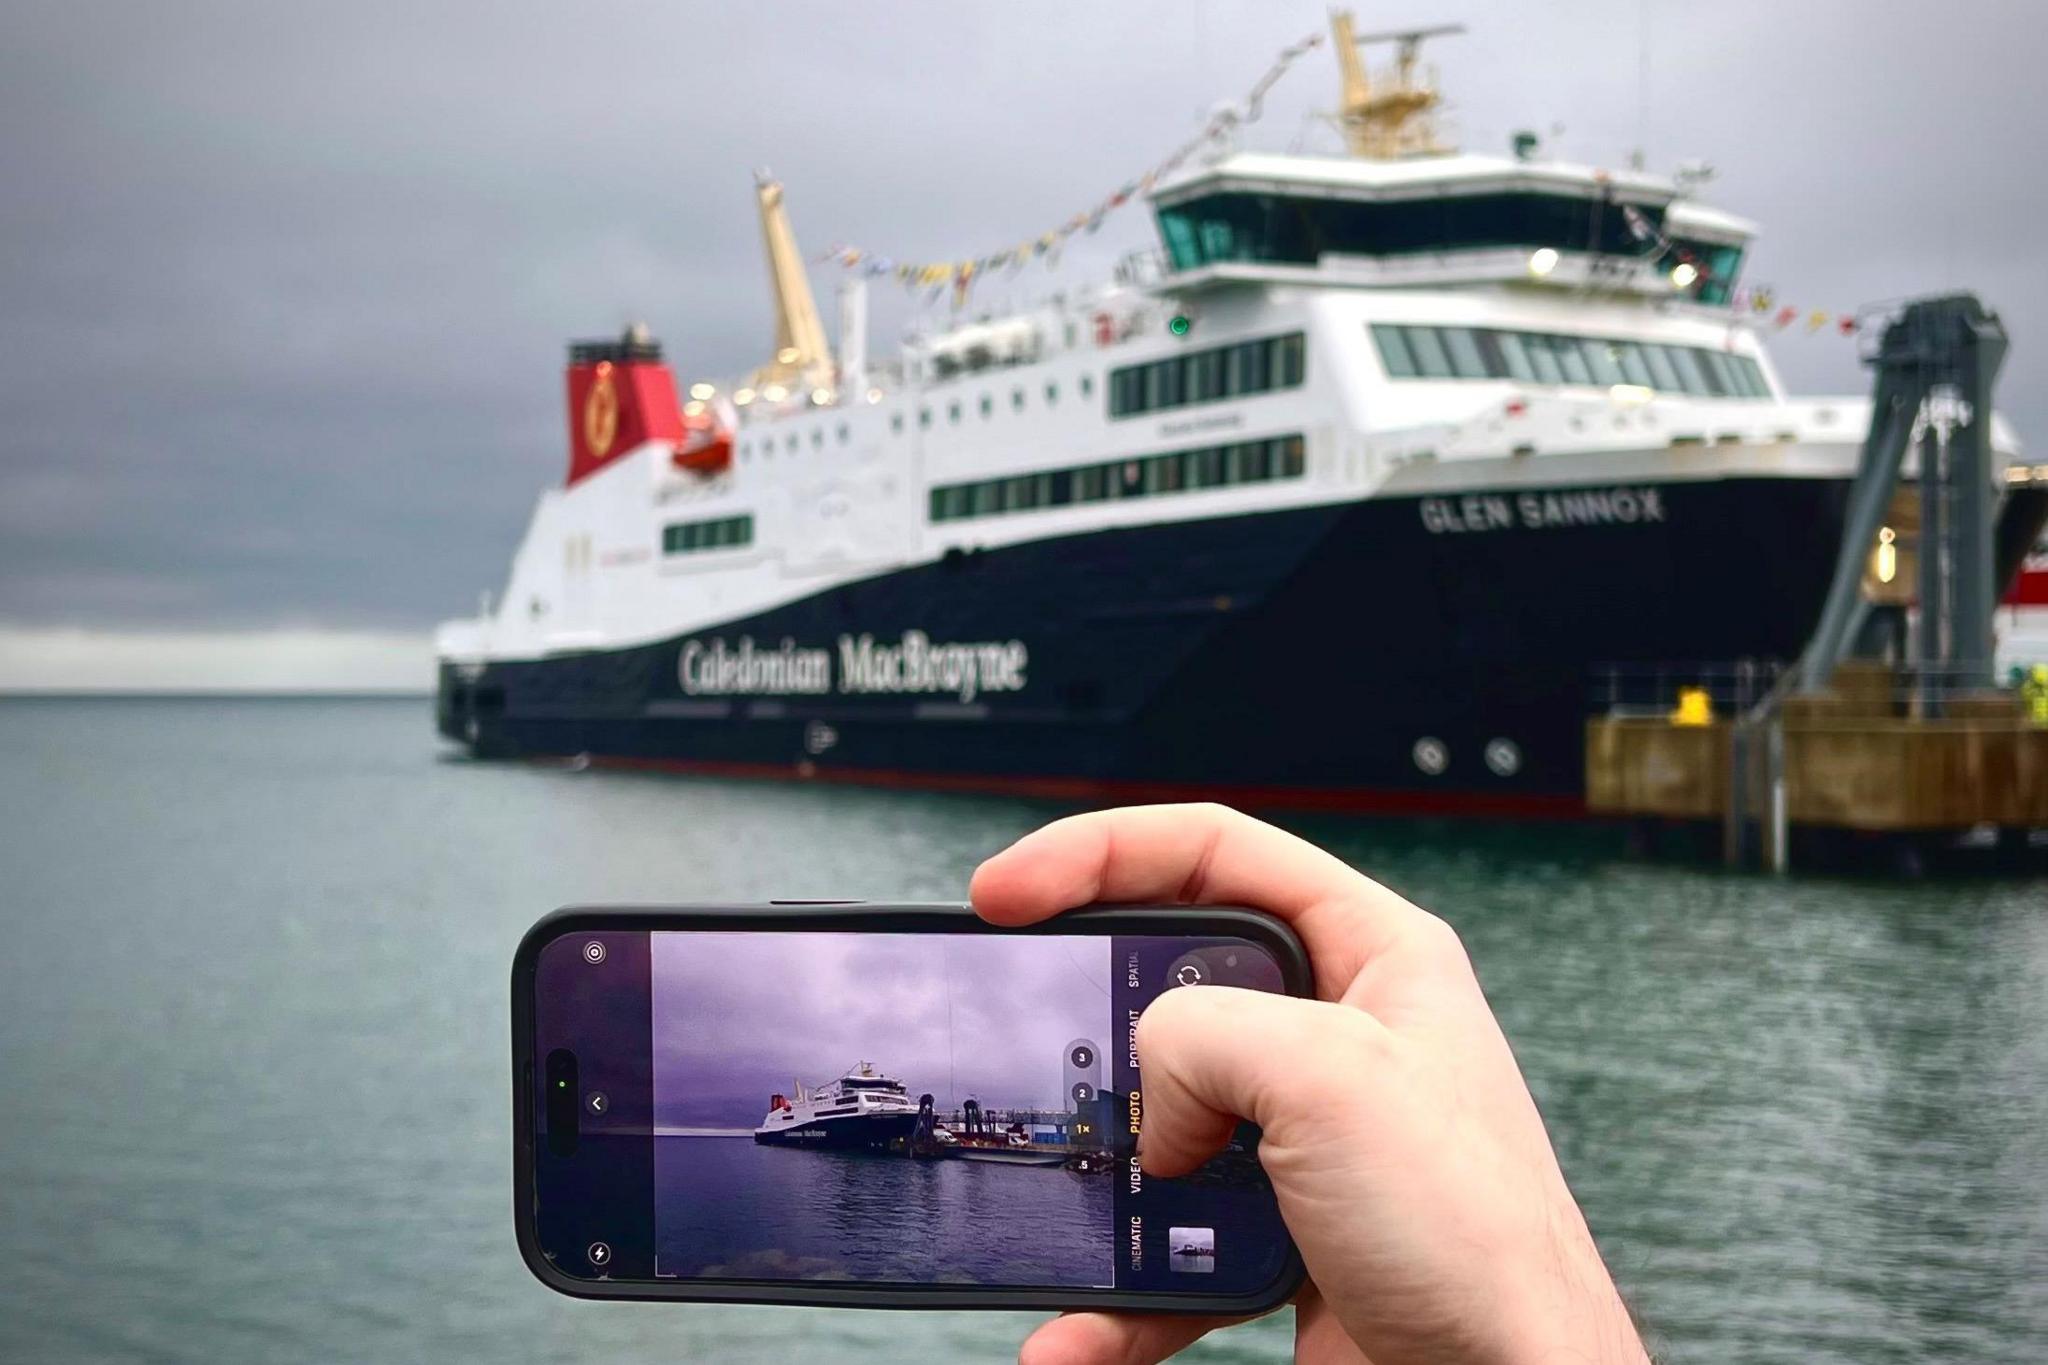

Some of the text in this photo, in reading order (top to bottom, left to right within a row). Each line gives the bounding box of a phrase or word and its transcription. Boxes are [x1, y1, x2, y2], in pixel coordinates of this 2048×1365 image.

[1420, 487, 1665, 533] GLEN SANNOX
[679, 629, 1028, 703] Caledonian MacBrayne
[1079, 1052, 1086, 1062] 3
[1079, 1088, 1086, 1098] 2
[1129, 1091, 1141, 1134] PHOTO
[1130, 1156, 1141, 1194] VIDEO
[1131, 1216, 1142, 1271] CINEMATIC
